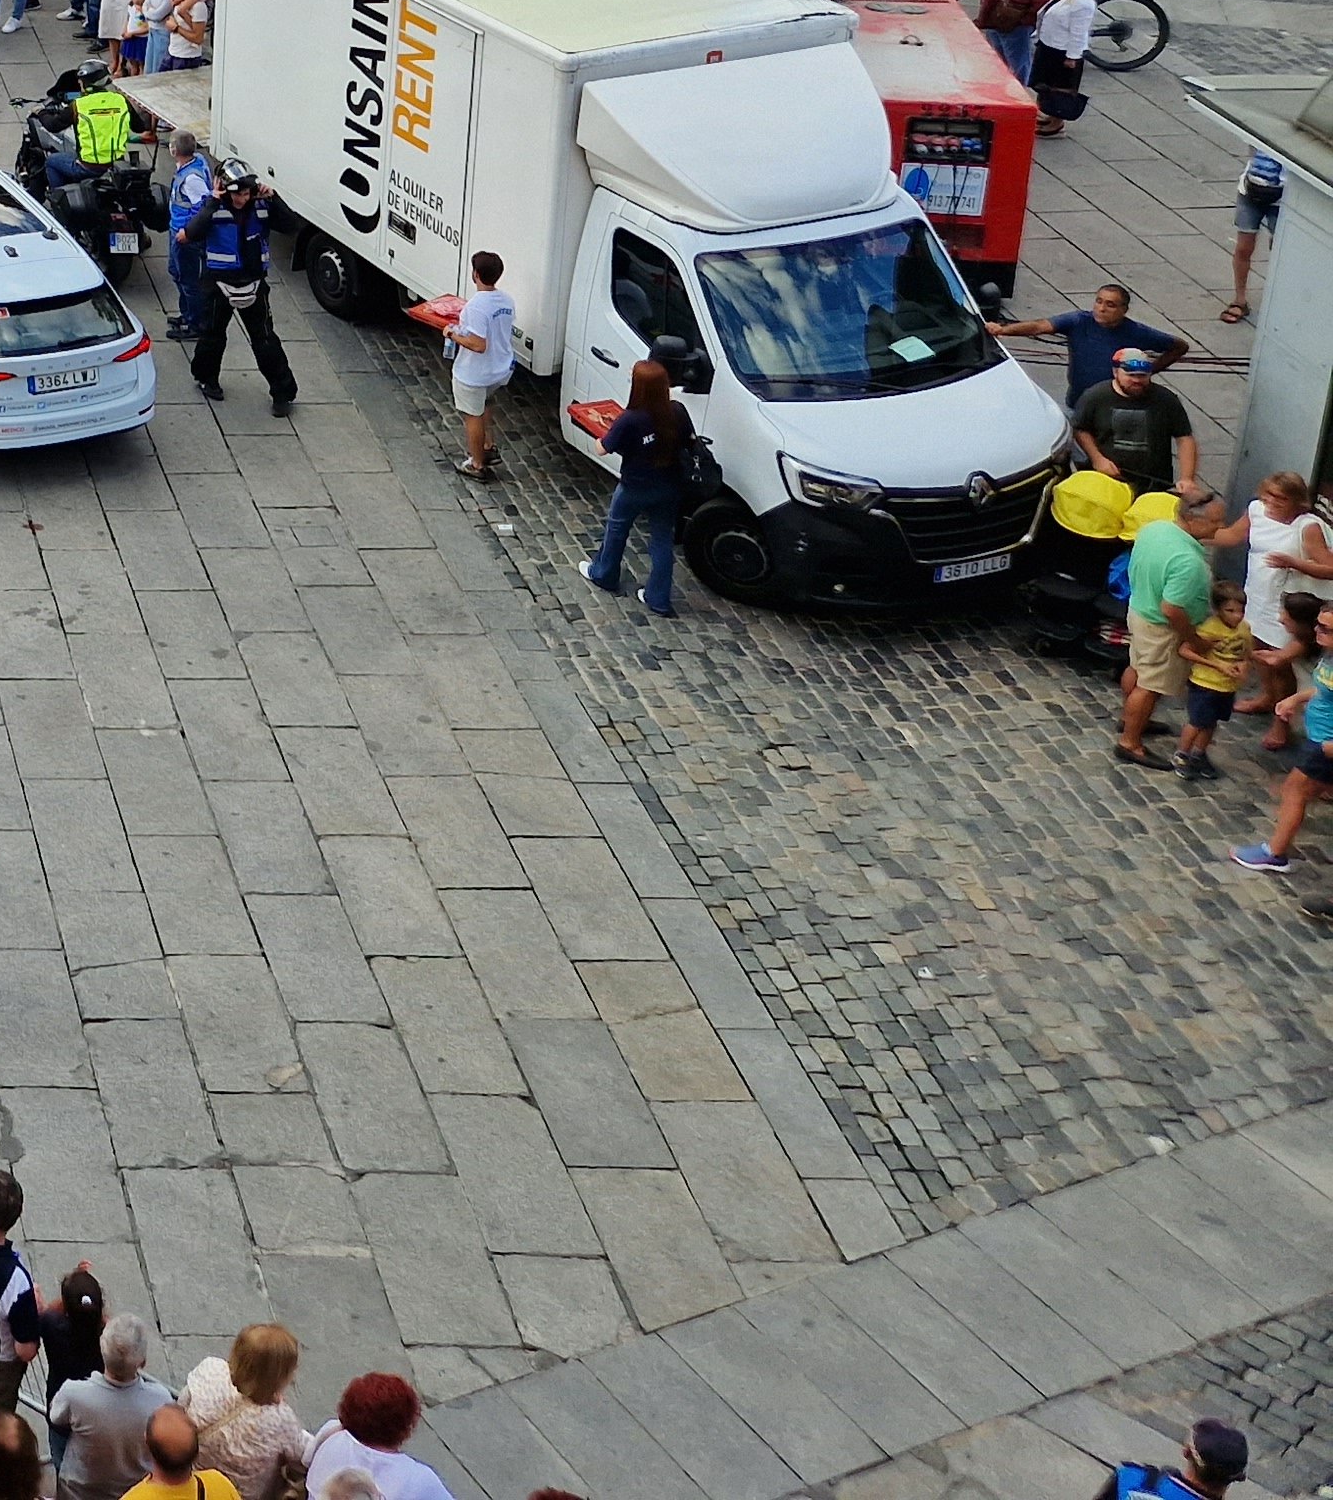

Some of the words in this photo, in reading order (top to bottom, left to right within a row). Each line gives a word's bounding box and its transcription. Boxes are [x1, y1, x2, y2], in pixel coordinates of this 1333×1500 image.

[388, 168, 444, 214] ALQUILER
[927, 195, 943, 208] 913
[961, 197, 976, 208] 741
[388, 190, 400, 210] DE
[402, 197, 460, 247] VEHÍCULOS
[38, 376, 69, 389] 3364
[73, 369, 97, 384] LWJ
[982, 555, 1008, 572] LLG
